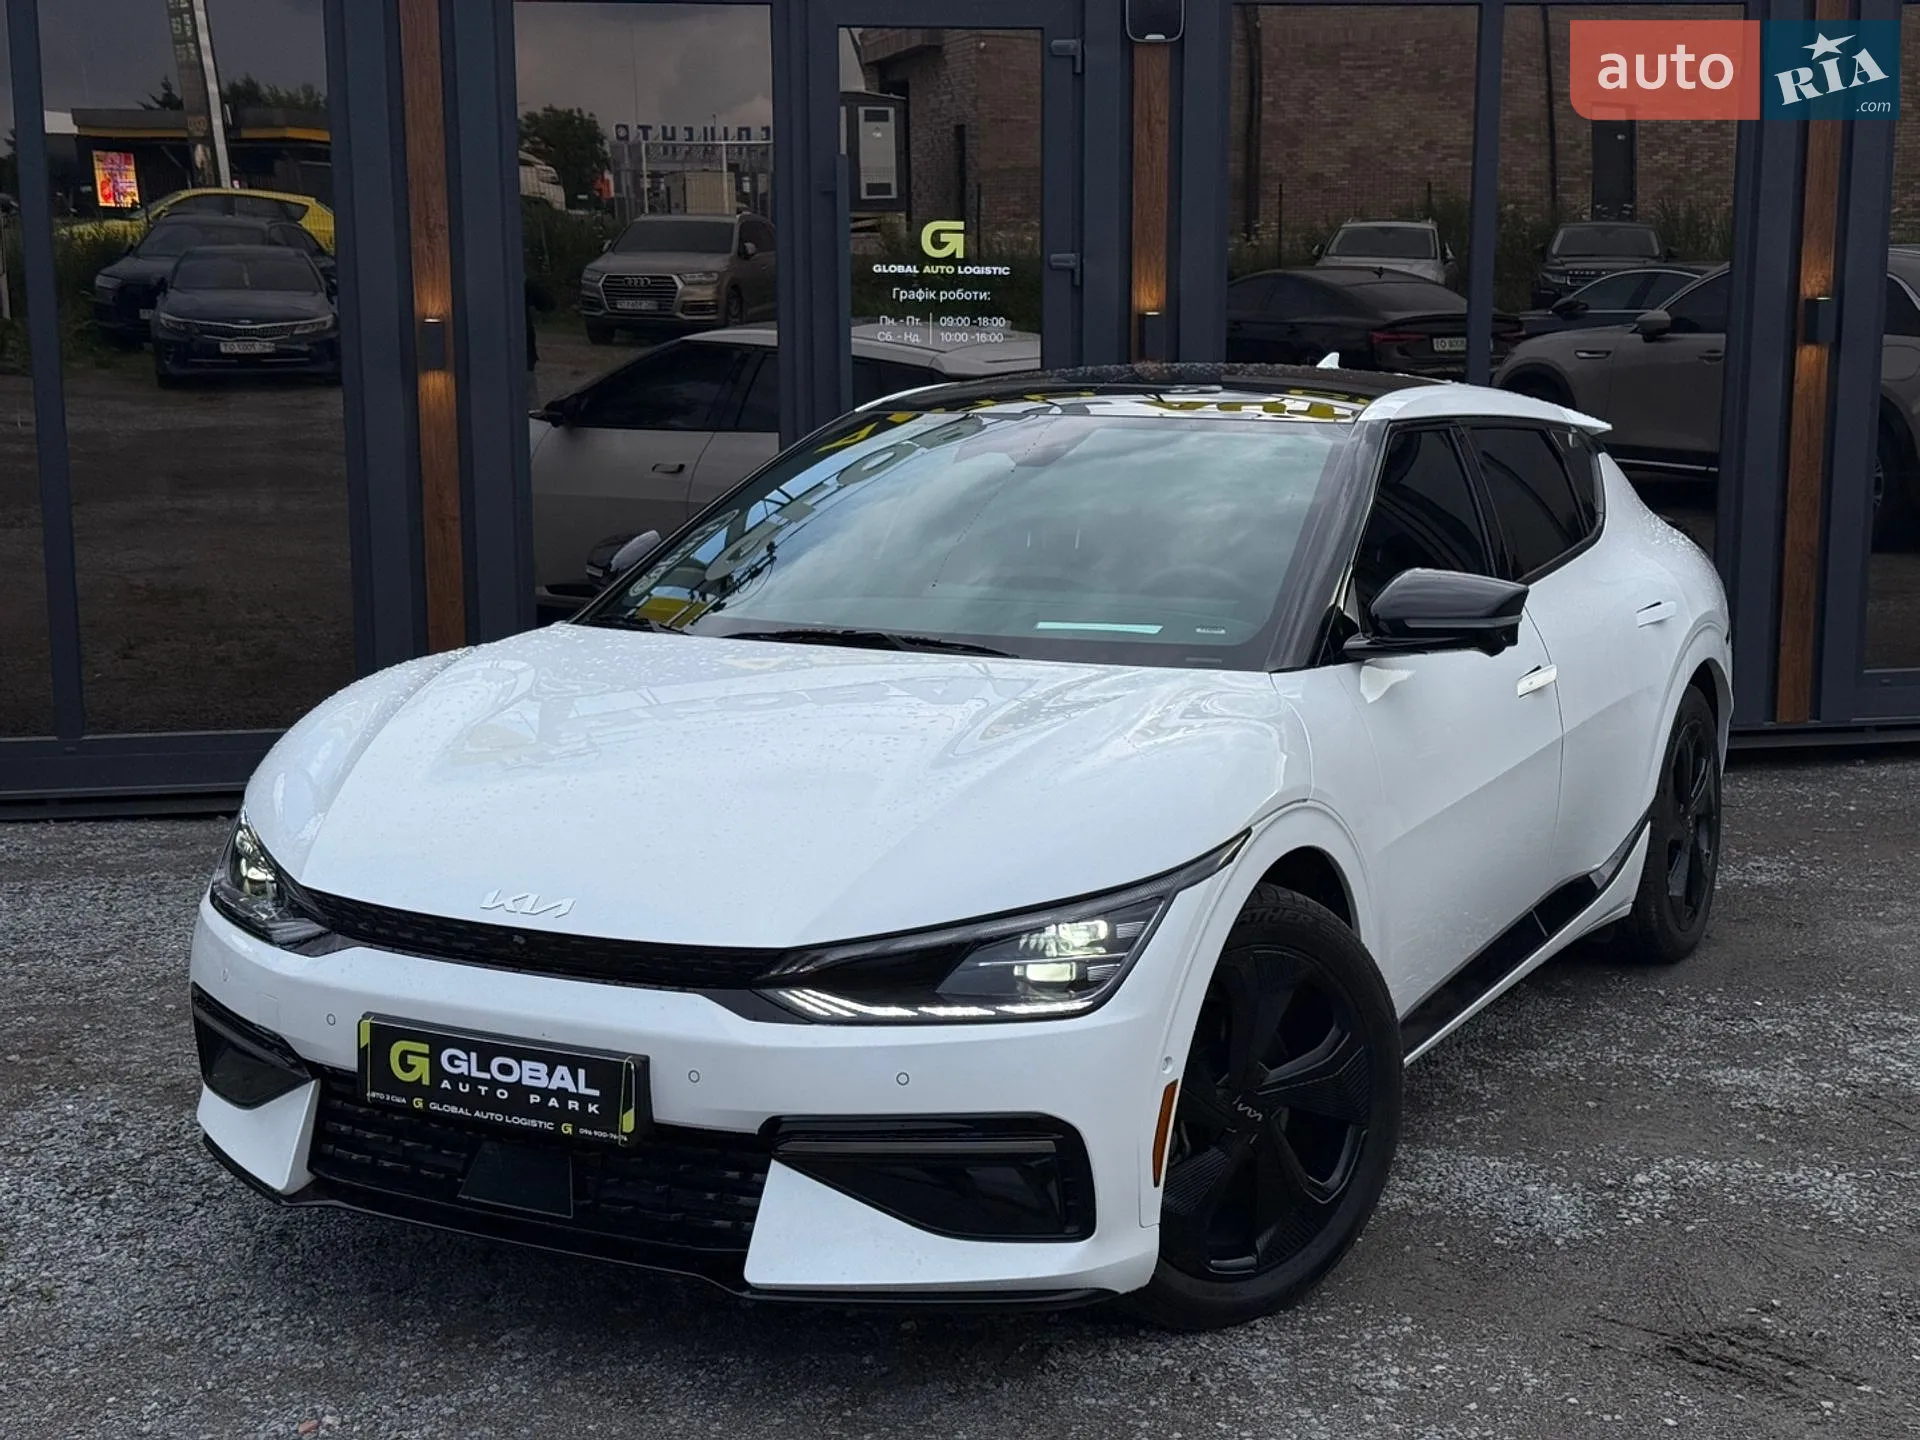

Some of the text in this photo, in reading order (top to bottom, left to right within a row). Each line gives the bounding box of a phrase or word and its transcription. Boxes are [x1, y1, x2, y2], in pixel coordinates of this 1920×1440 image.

[872, 264, 1011, 275] GLOBAL AUTO LOGISTIC
[892, 287, 991, 303] Графік роботи:
[879, 315, 898, 326] Пн.
[906, 315, 922, 326] Пт.
[939, 316, 971, 328] 09:00
[877, 331, 895, 342] Сб.
[940, 332, 968, 343] 10:00
[440, 1048, 600, 1096] GLOBAL
[440, 1079, 600, 1114] AUTO PARK
[429, 1102, 472, 1116] GLOBAL
[473, 1110, 504, 1122] AUTO
[505, 1115, 555, 1130] LOGISTIC
